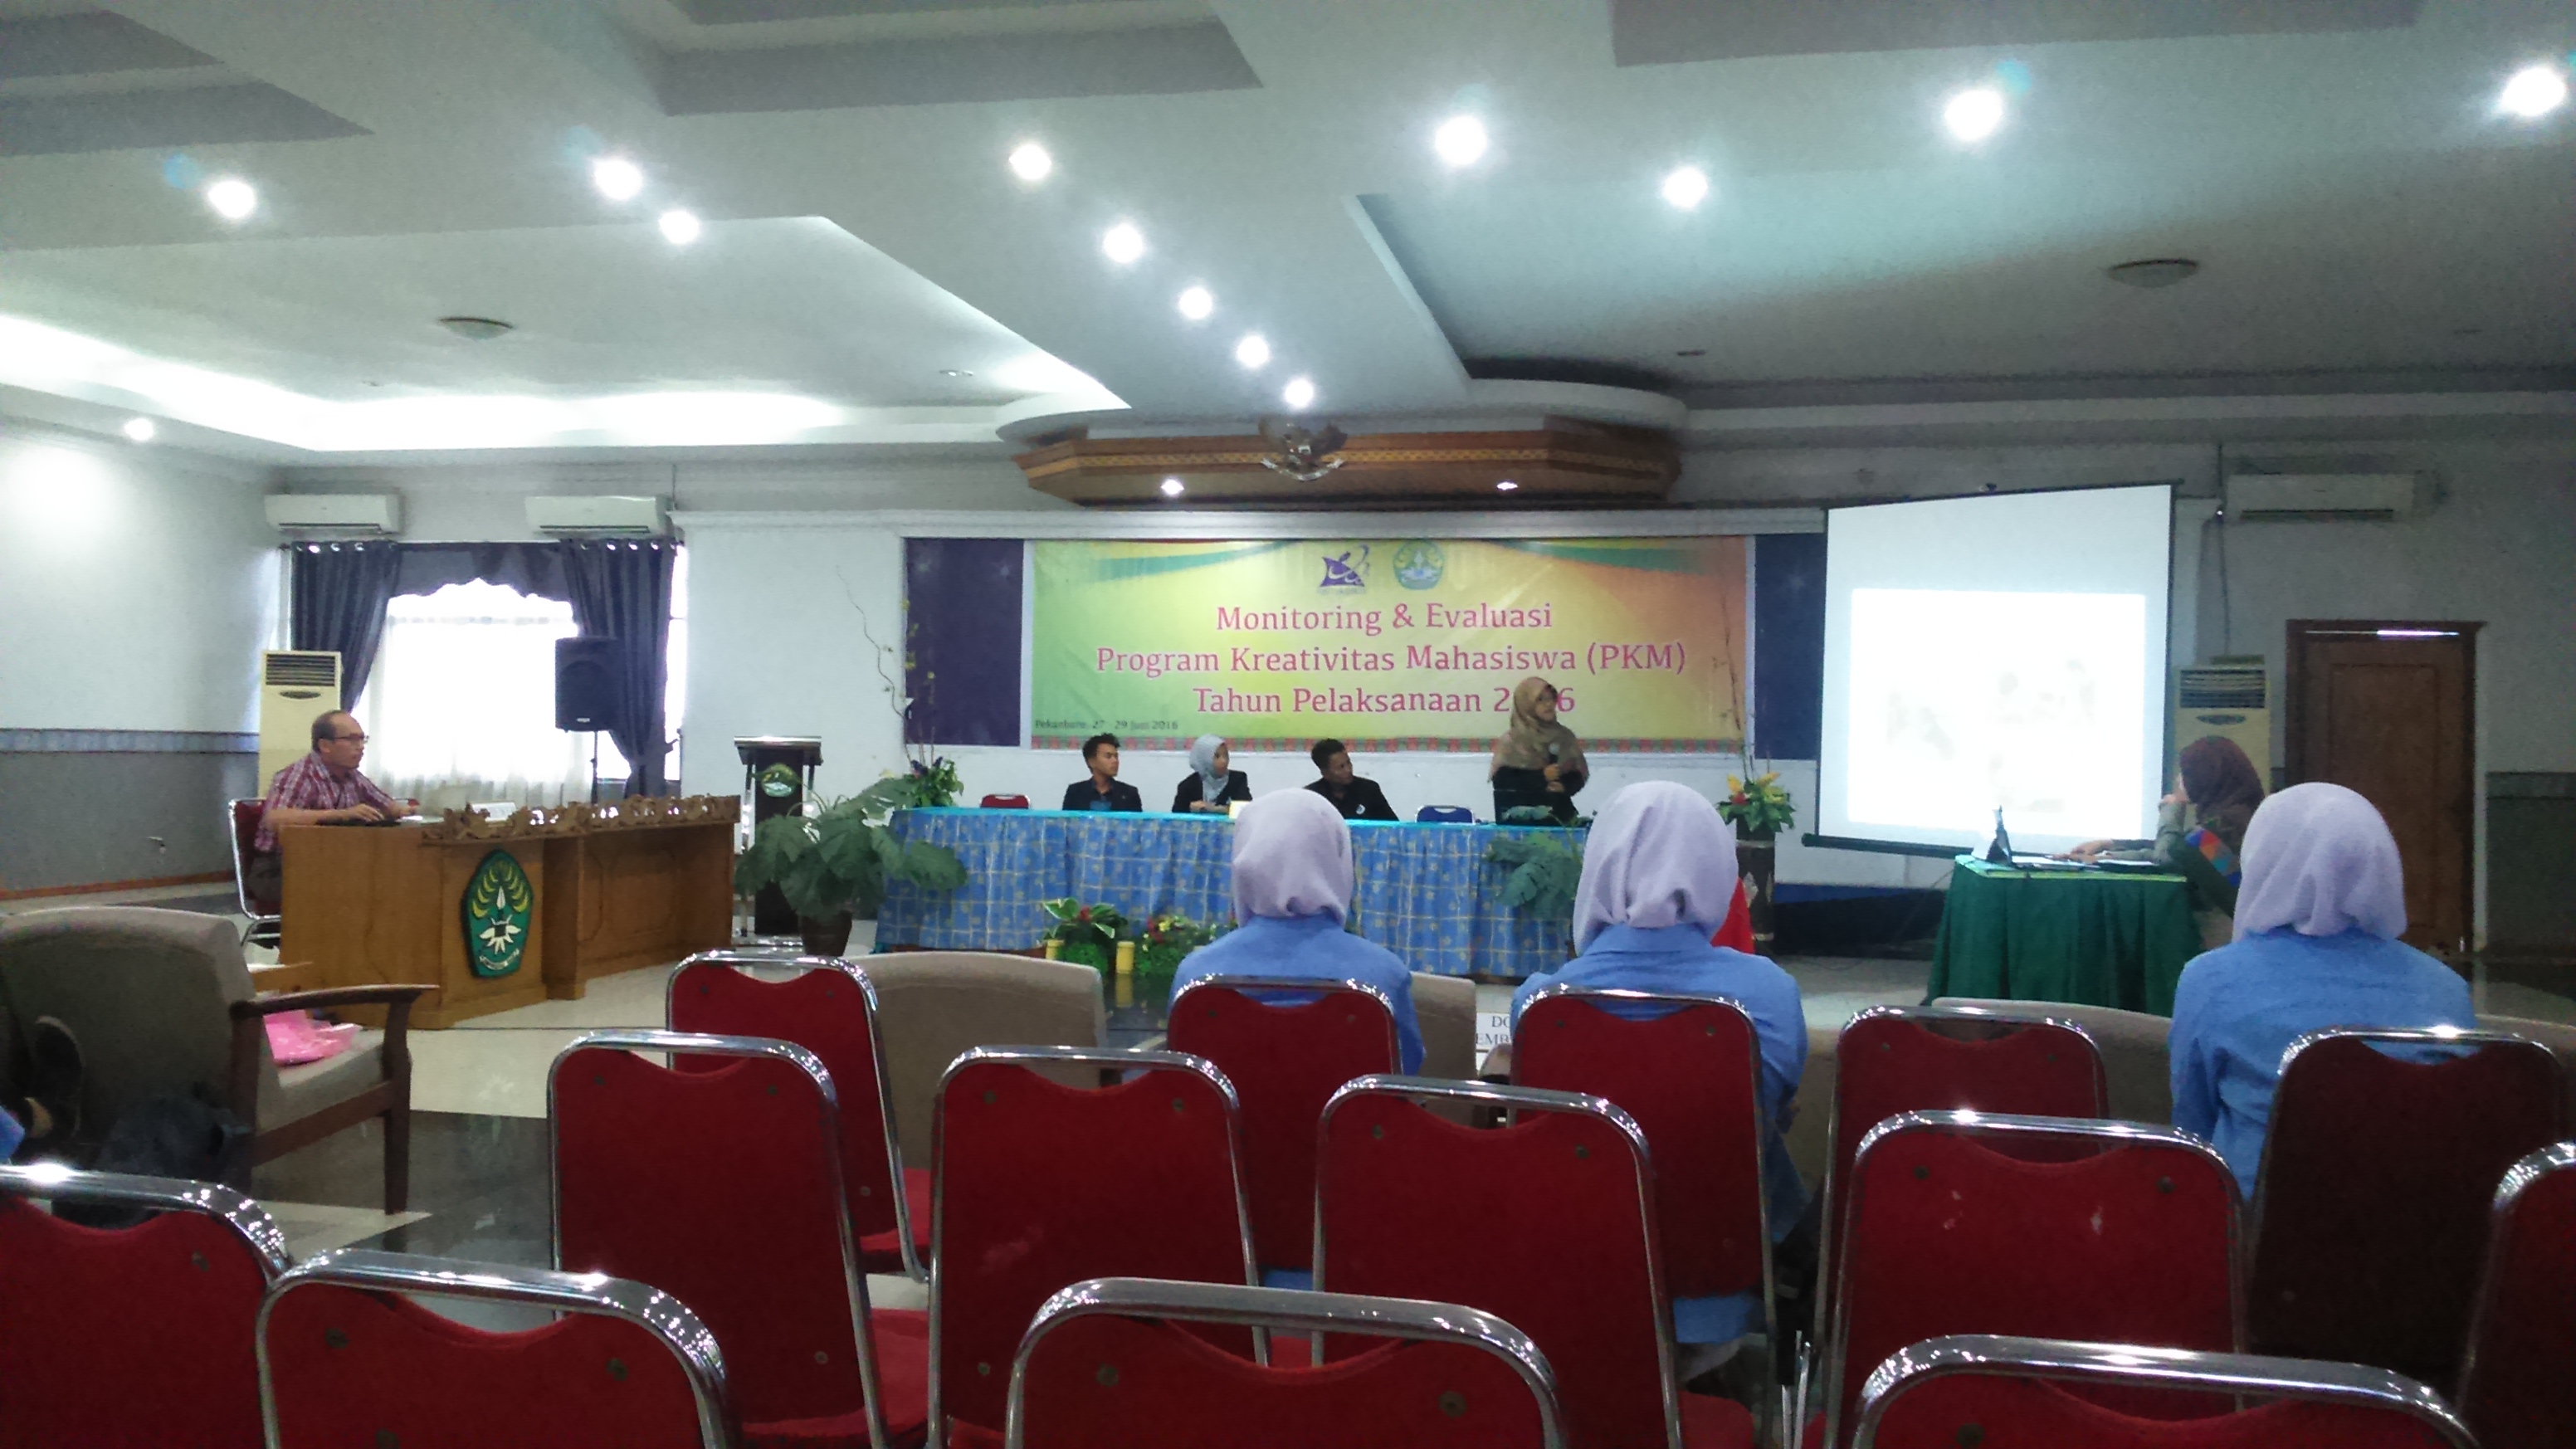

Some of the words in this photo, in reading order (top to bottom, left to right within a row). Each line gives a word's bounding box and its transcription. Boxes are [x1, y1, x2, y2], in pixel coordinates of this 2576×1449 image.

[1217, 606, 1382, 637] Monitoring
[1392, 603, 1414, 628] &
[1426, 603, 1552, 628] Evaluasi
[1096, 647, 1219, 678] Program
[1230, 646, 1395, 671] Kreativitas
[1406, 644, 1576, 671] Mahasiswa
[1587, 642, 1686, 676] (PKM)
[1193, 688, 1281, 712] Tahun
[1292, 687, 1481, 712] Pelaksanaan
[1493, 686, 1575, 712] 26
[1115, 720, 1128, 729] 29
[1152, 720, 1178, 730] 2016
